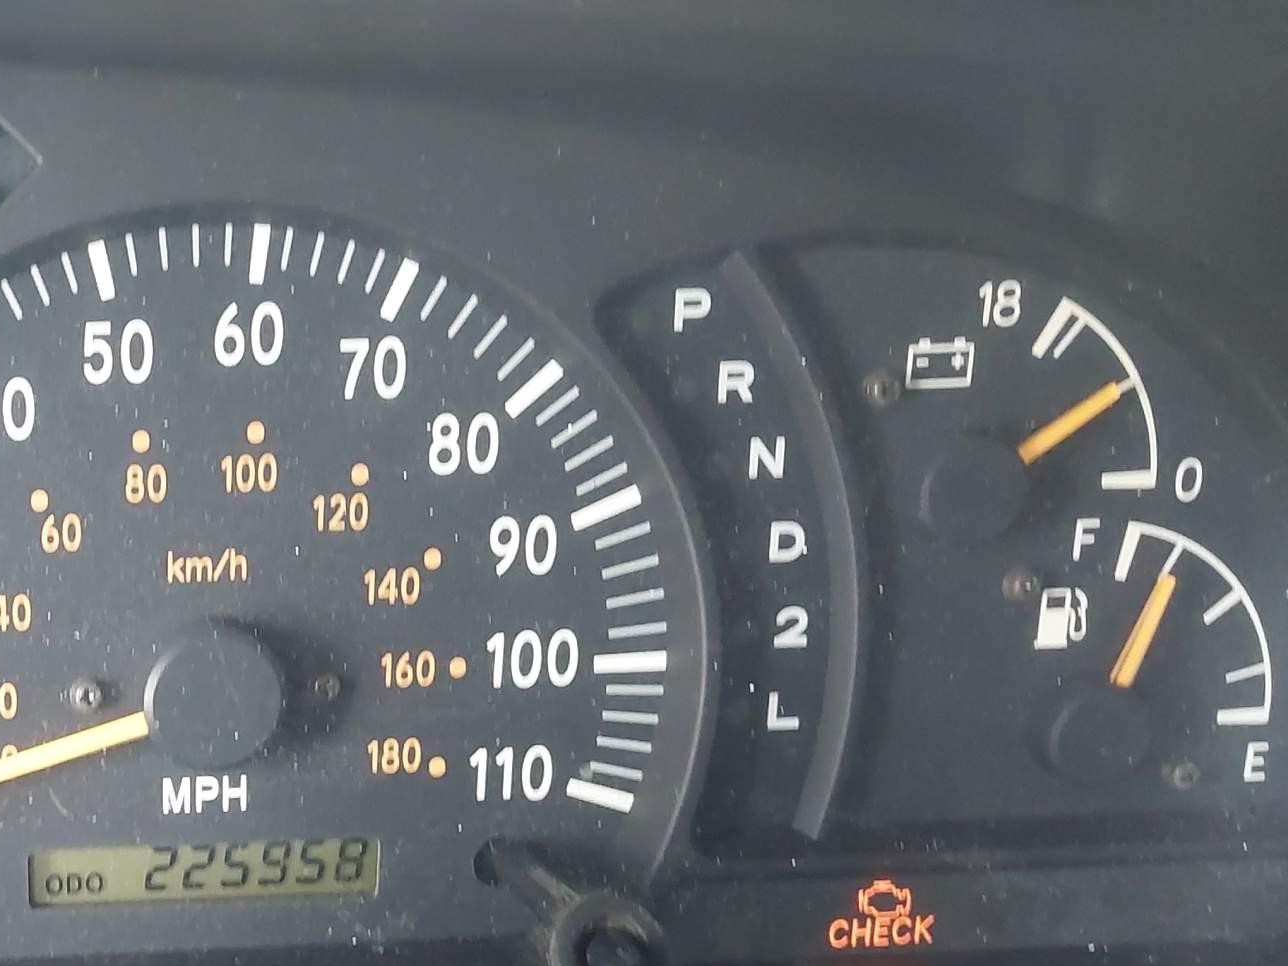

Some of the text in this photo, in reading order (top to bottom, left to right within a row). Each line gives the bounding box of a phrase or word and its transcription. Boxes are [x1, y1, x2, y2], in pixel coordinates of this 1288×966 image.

[674, 288, 711, 331] P
[980, 280, 1021, 326] 18
[84, 319, 153, 384] 50
[215, 302, 283, 366] 60
[340, 336, 406, 399] 70
[718, 361, 754, 403] R
[429, 413, 498, 475] 80
[749, 437, 785, 478] N
[126, 464, 166, 503] 80
[222, 453, 276, 492] 100
[42, 513, 81, 552] 60
[314, 493, 368, 531] 120
[490, 515, 556, 576] 90
[769, 521, 807, 562] D
[1073, 518, 1100, 561] F
[168, 549, 247, 582] km/h
[365, 567, 420, 604] 140
[774, 607, 808, 647] 2
[382, 650, 435, 688] 160
[487, 629, 578, 688] 100
[767, 692, 799, 729] L
[368, 738, 420, 773] 180
[470, 745, 552, 801] 110
[1244, 742, 1268, 781] E
[162, 774, 248, 815] MPH
[44, 837, 369, 895] ODO 225958
[828, 920, 935, 949] CHECK
